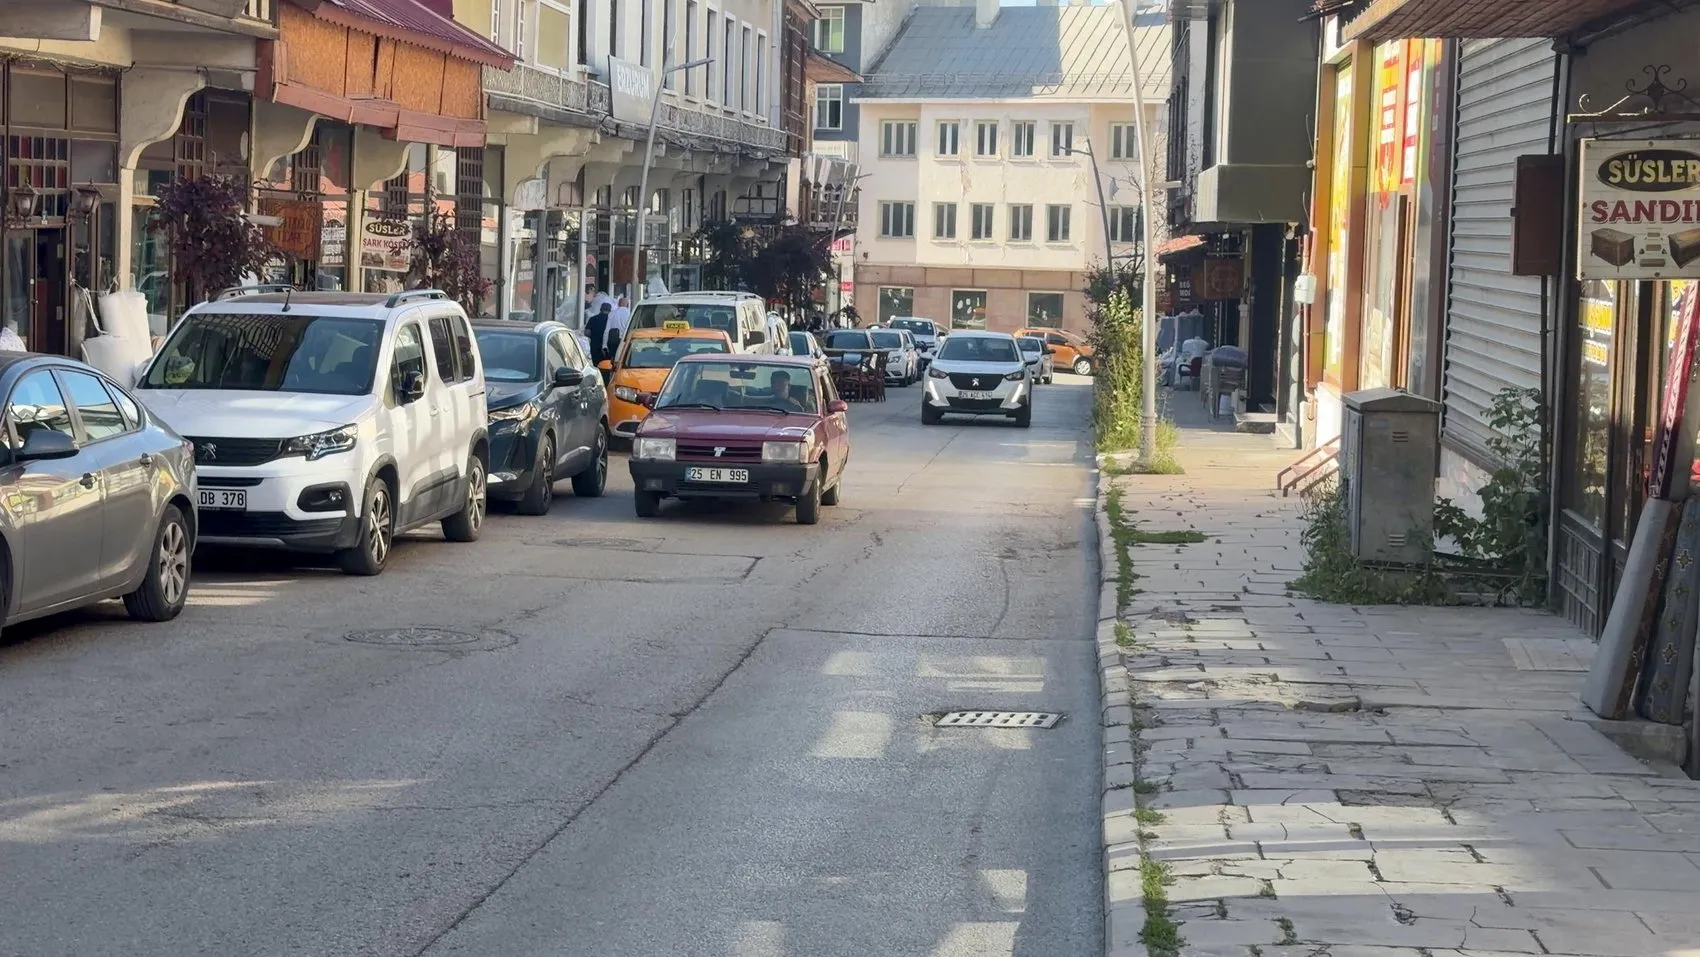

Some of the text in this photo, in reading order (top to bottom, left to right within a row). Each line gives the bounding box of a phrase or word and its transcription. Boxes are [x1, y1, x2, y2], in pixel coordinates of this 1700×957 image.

[1608, 154, 1700, 183] SÜSLER
[1591, 200, 1700, 224] SANDI
[691, 469, 747, 481] 25 EN 995
[197, 491, 244, 506] DB 378
